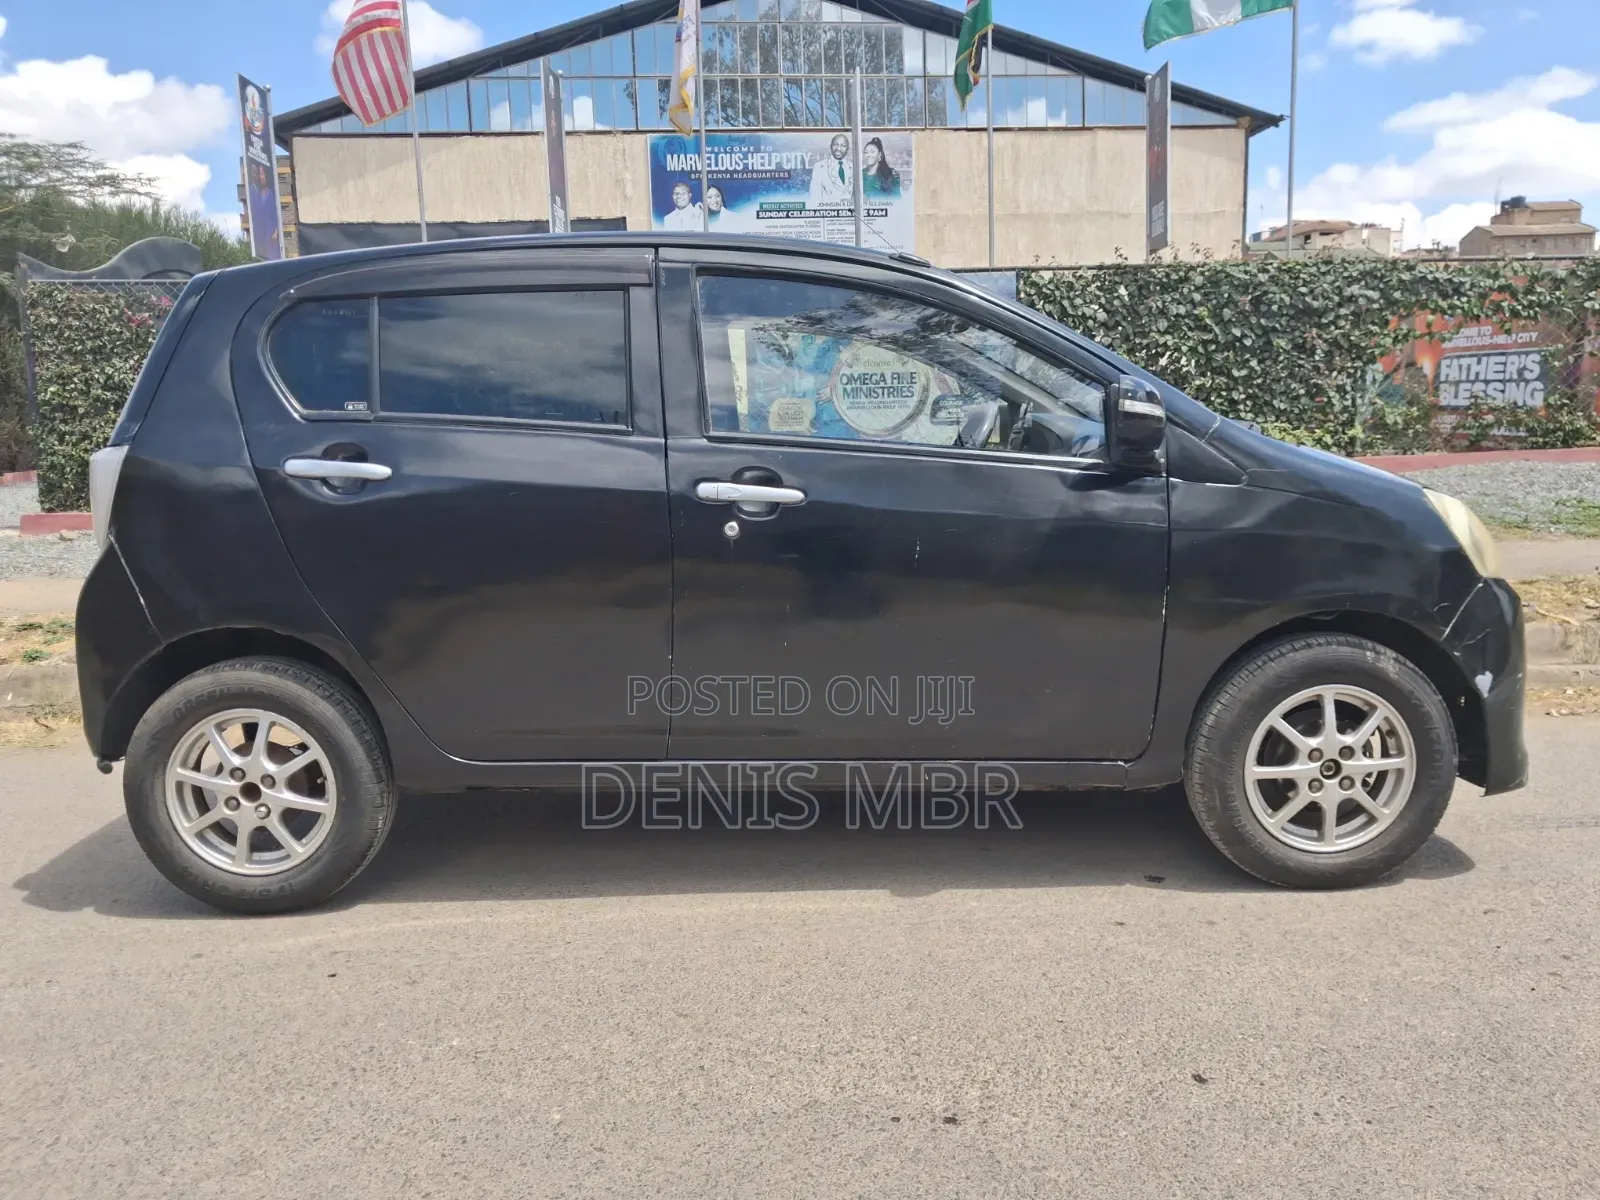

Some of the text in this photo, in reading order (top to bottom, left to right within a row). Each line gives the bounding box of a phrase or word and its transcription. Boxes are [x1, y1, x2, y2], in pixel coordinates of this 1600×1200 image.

[782, 152, 811, 170] CITY
[788, 210, 838, 218] CELEBRATION
[869, 209, 886, 217] 9AM
[1517, 332, 1538, 343] CITY
[1440, 353, 1541, 381] FATHER'S
[839, 371, 918, 386] OMEGA FIRE
[842, 385, 915, 400] MINISTRIES
[1438, 380, 1545, 407] BLESSING
